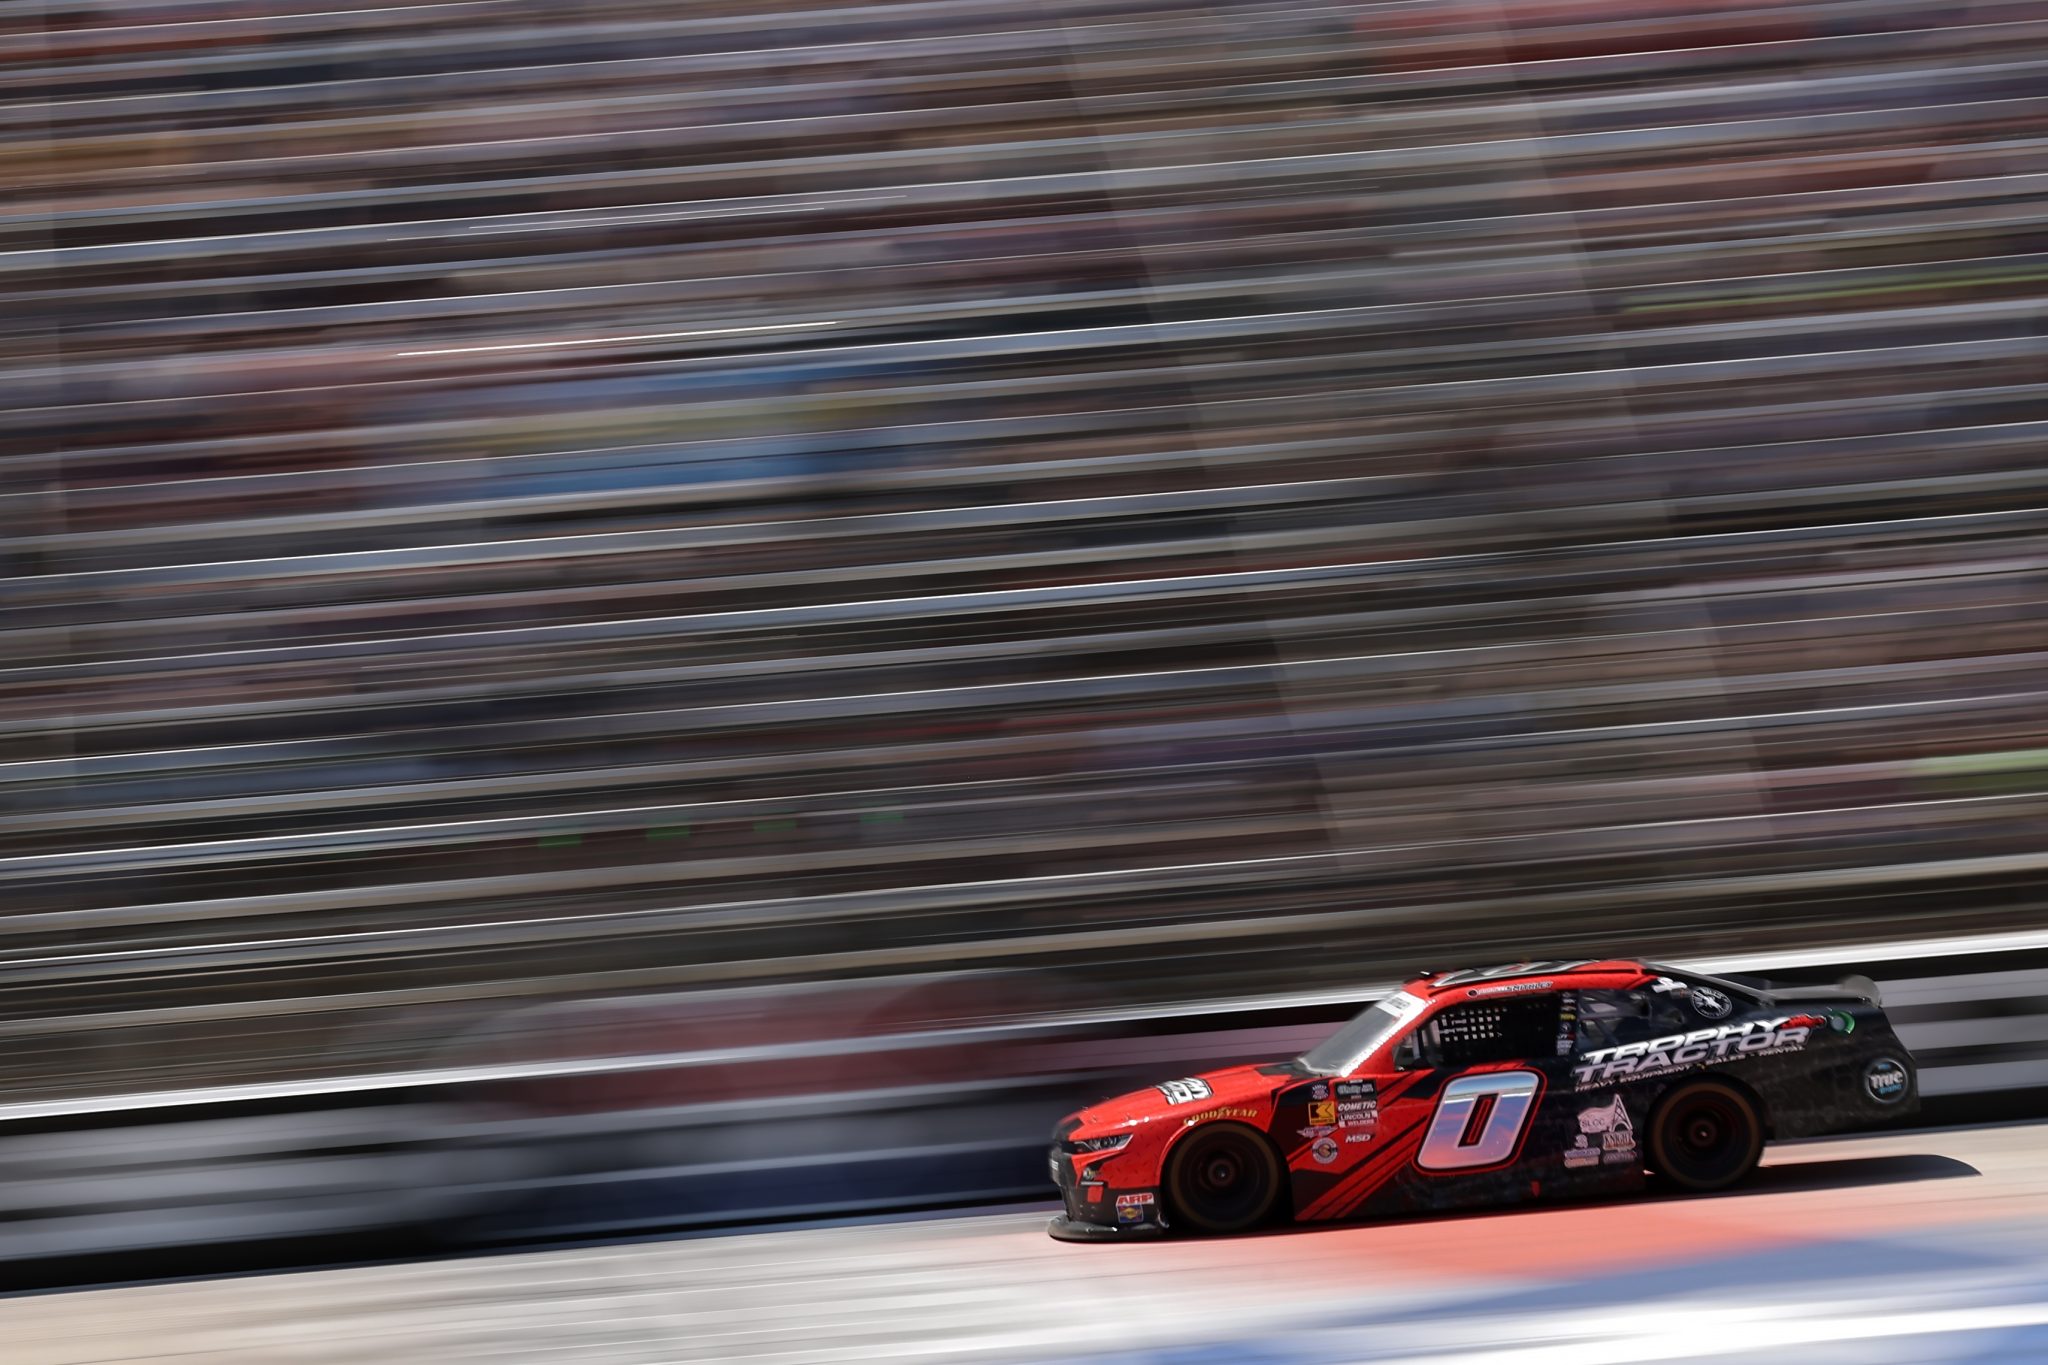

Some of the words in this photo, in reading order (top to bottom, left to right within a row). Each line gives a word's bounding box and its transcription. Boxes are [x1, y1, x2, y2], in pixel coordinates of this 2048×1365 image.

[1581, 1017, 1790, 1065] TROPHY
[1574, 1027, 1810, 1083] TRACTOR
[1575, 1080, 1616, 1092] HEAVY
[1619, 1065, 1692, 1083] EQUIPMENT
[1705, 1054, 1745, 1066] SALES
[1760, 1046, 1806, 1057] RENTAL
[1338, 1100, 1377, 1111] COMETIC
[1183, 1108, 1258, 1126] GOODYEAR
[1340, 1112, 1371, 1121] LINCOLN
[1418, 1071, 1539, 1169] 0
[1345, 1134, 1371, 1143] MSD
[1117, 1194, 1153, 1205] ARP
